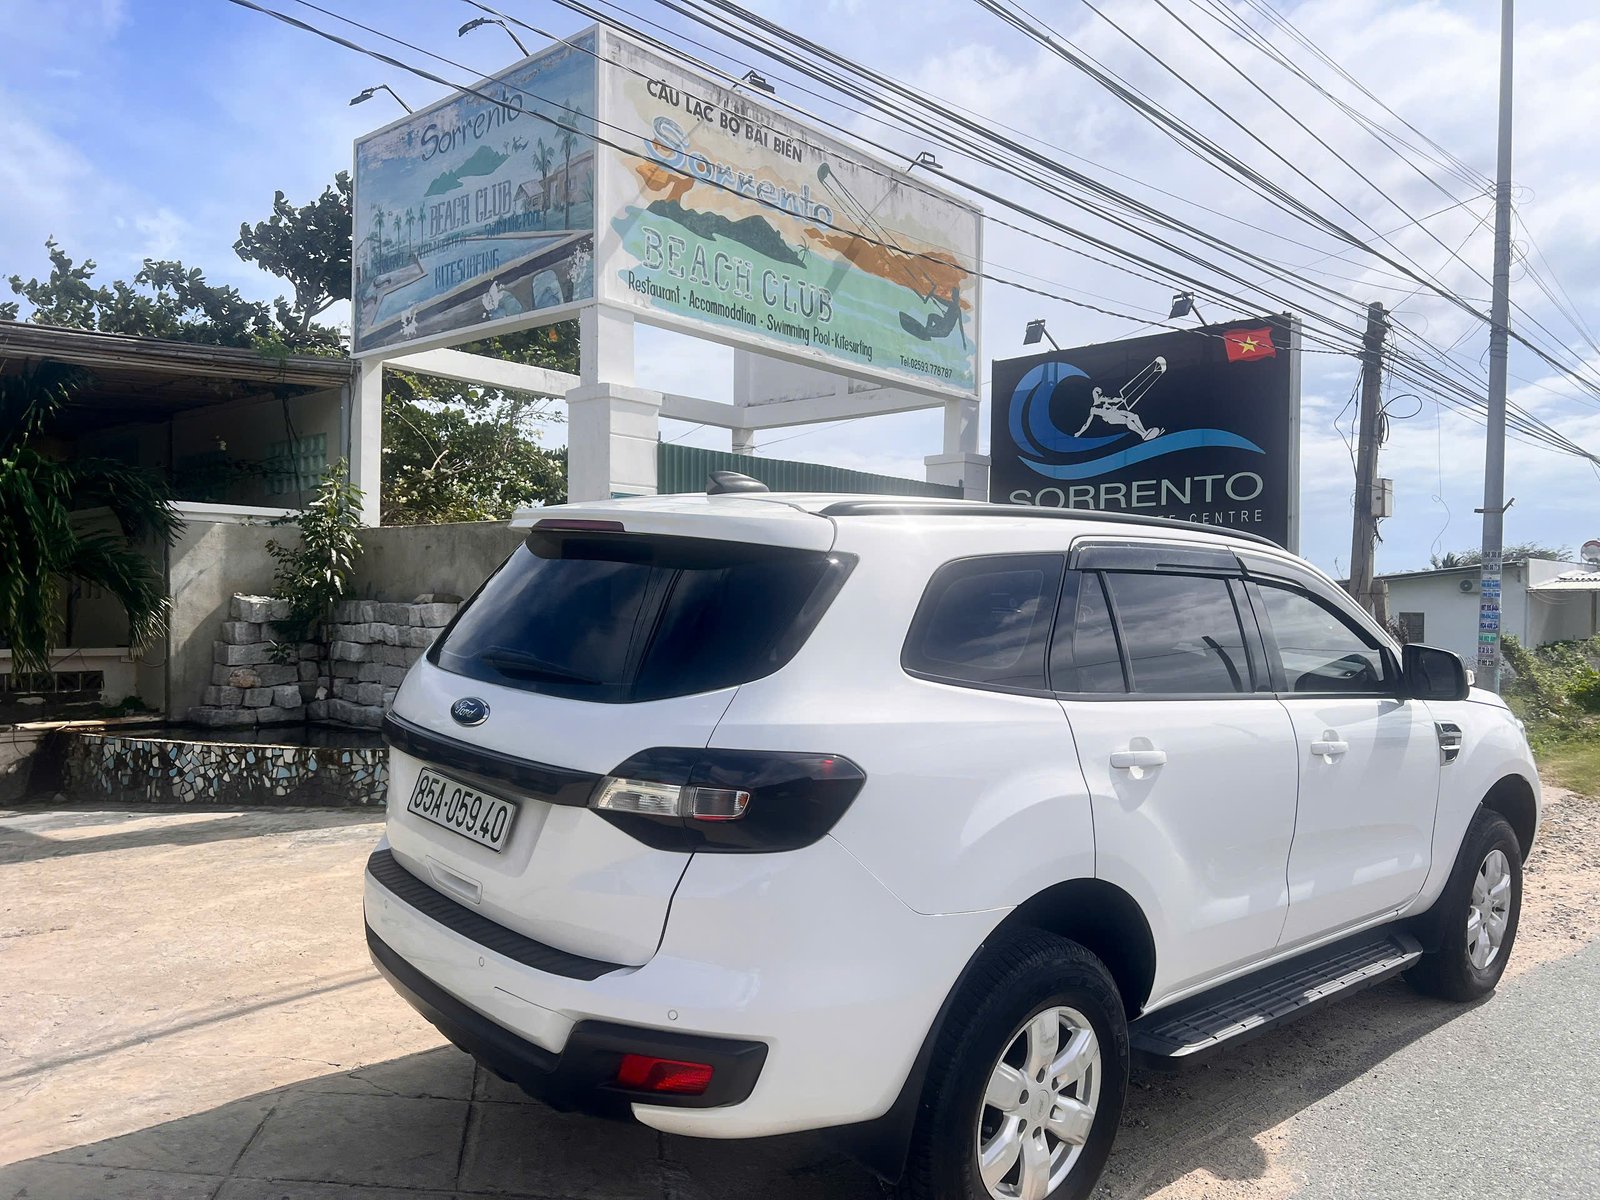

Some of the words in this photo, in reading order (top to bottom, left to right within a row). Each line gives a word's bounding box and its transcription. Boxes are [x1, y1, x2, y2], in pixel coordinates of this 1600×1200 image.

[421, 87, 523, 162] Sorrento
[685, 97, 714, 122] LẠC
[643, 115, 834, 230] Sorrento
[429, 193, 470, 238] BEACH
[475, 180, 512, 223] CLUB
[641, 225, 753, 300] BEACH
[762, 269, 834, 323] CLUB
[628, 270, 680, 304] Restaurant
[688, 290, 757, 326] Accommodation
[766, 314, 810, 346] Swimming
[1009, 471, 1264, 510] SORRENTO
[1189, 509, 1262, 525] CENTRE
[455, 700, 478, 718] Ford
